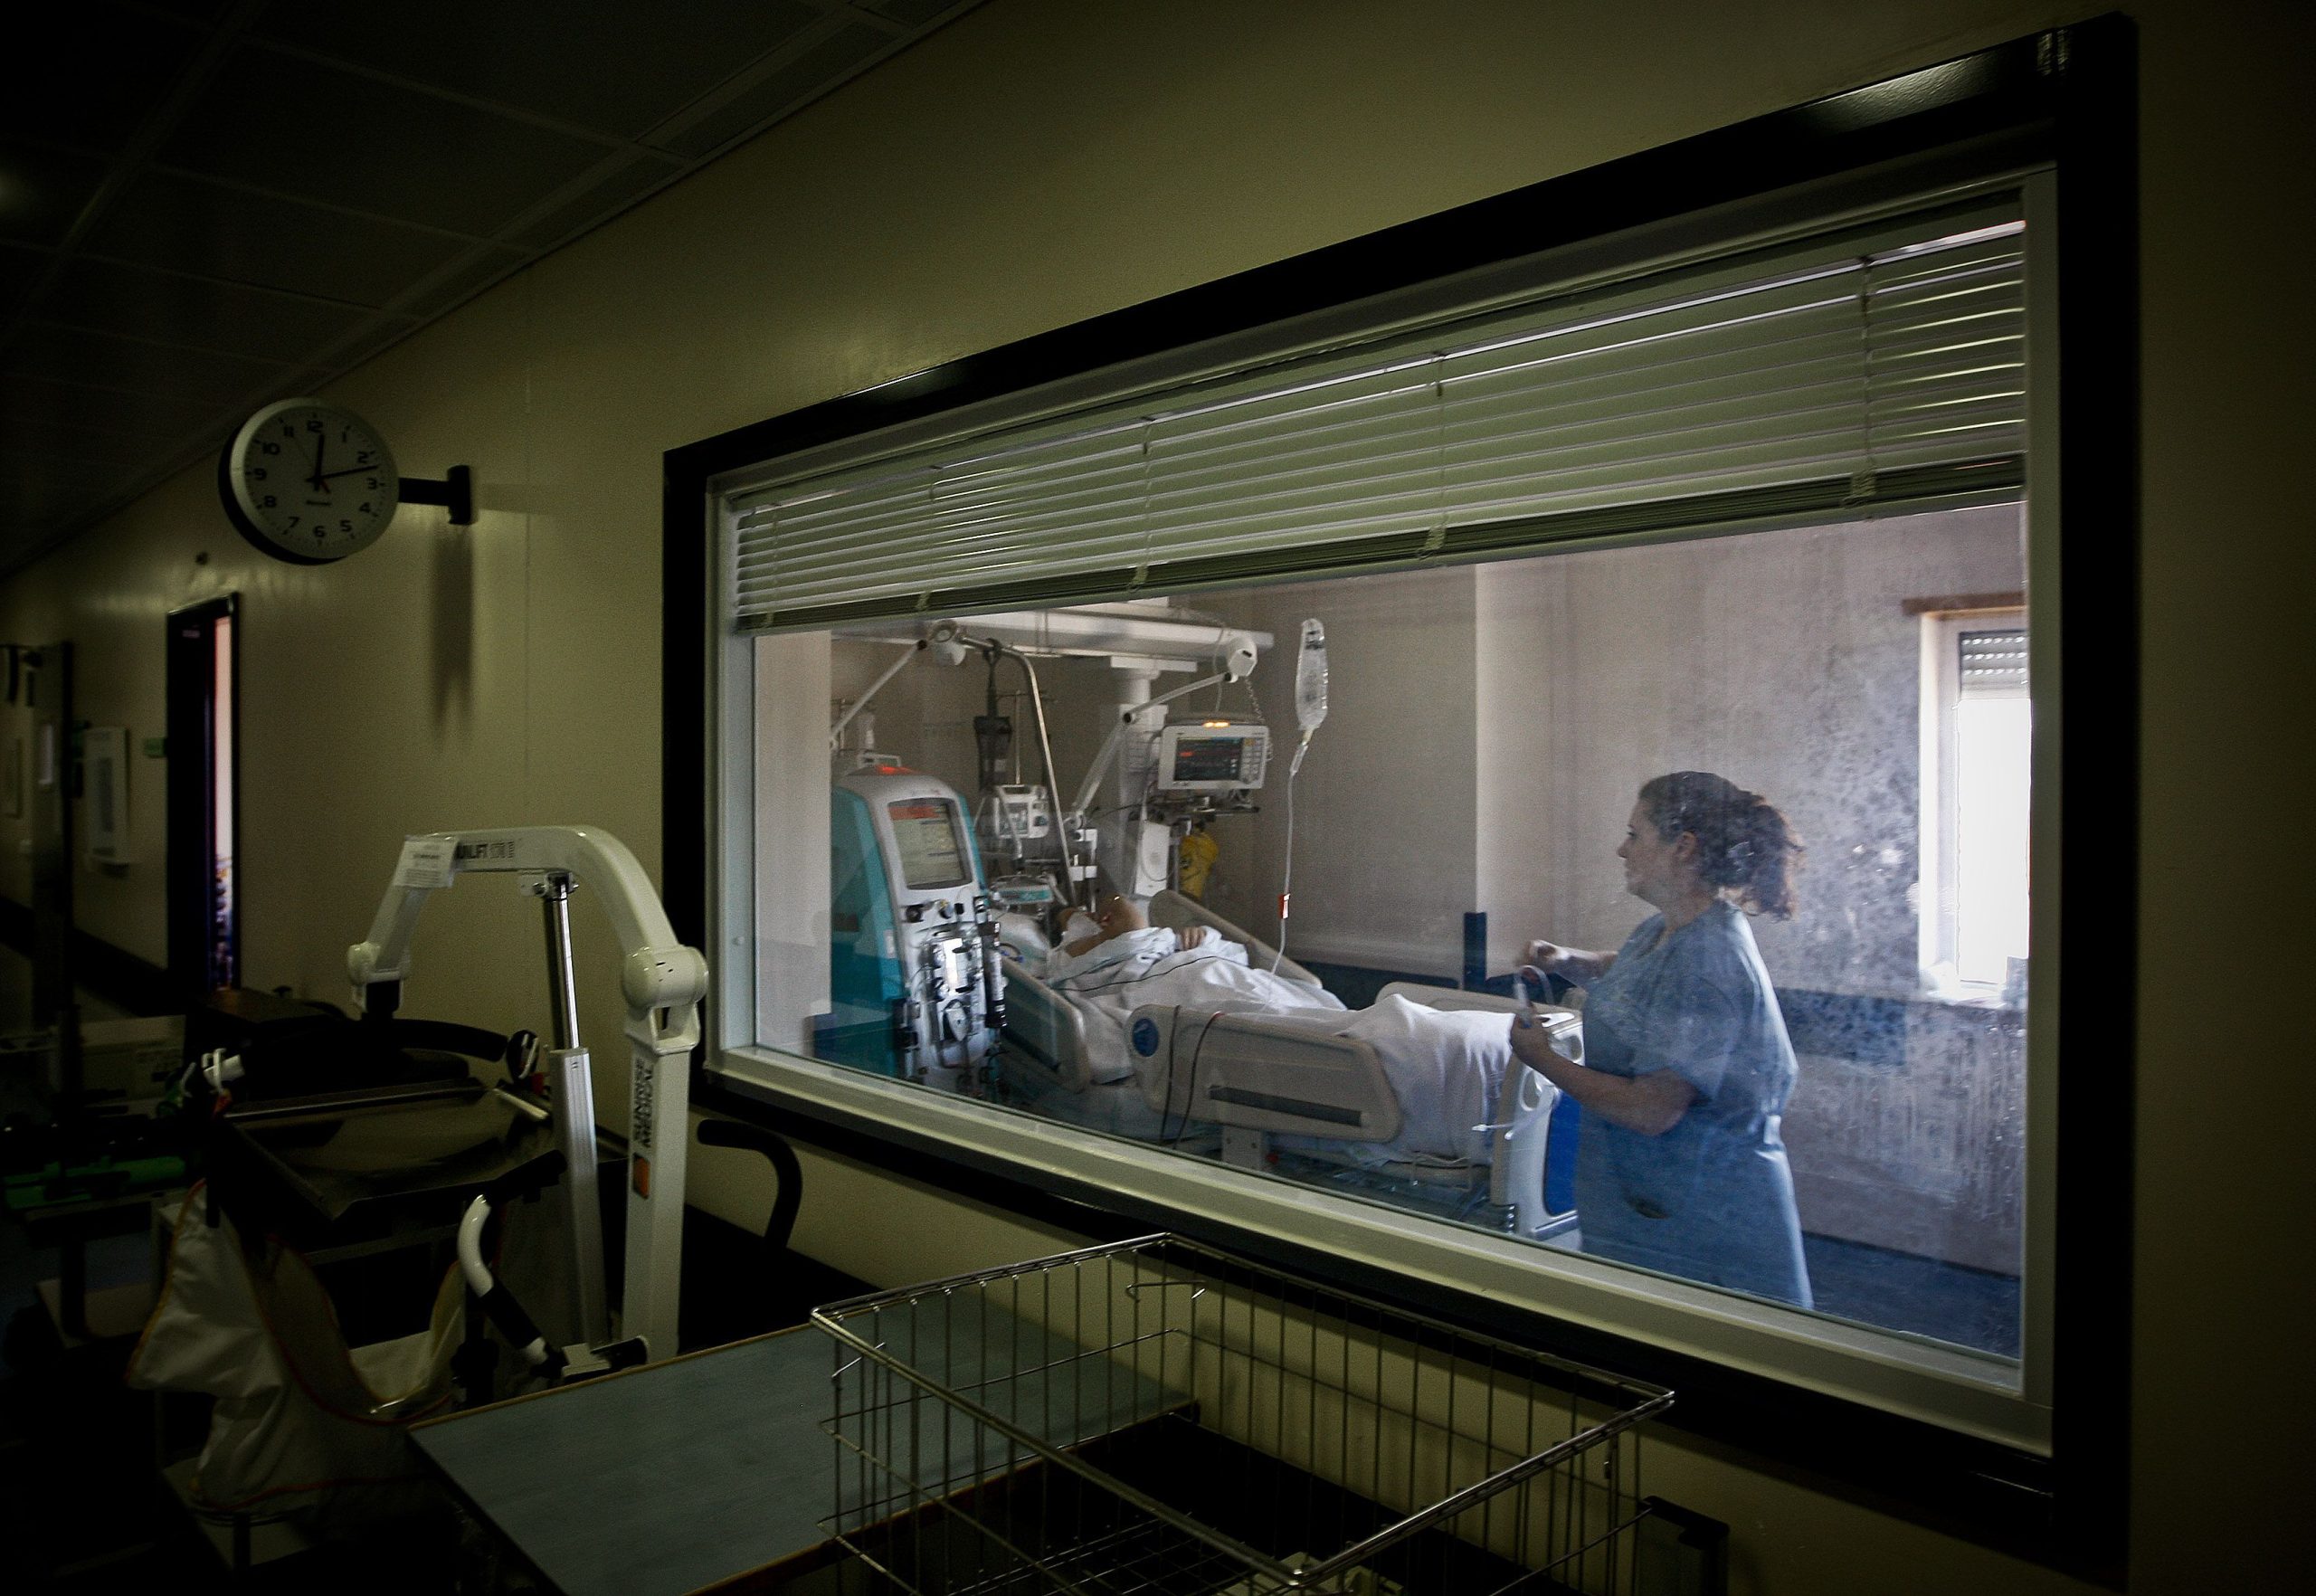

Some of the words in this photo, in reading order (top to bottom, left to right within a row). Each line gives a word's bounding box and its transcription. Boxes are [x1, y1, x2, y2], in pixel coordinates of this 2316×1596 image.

[307, 420, 323, 433] 12
[262, 442, 280, 455] 10
[357, 451, 369, 463] 2
[254, 468, 267, 480] 9
[366, 478, 377, 489] 3
[264, 495, 277, 508] 8
[359, 502, 371, 513] 4
[289, 516, 299, 528] 7
[340, 519, 352, 532] 5
[314, 526, 326, 537] 6
